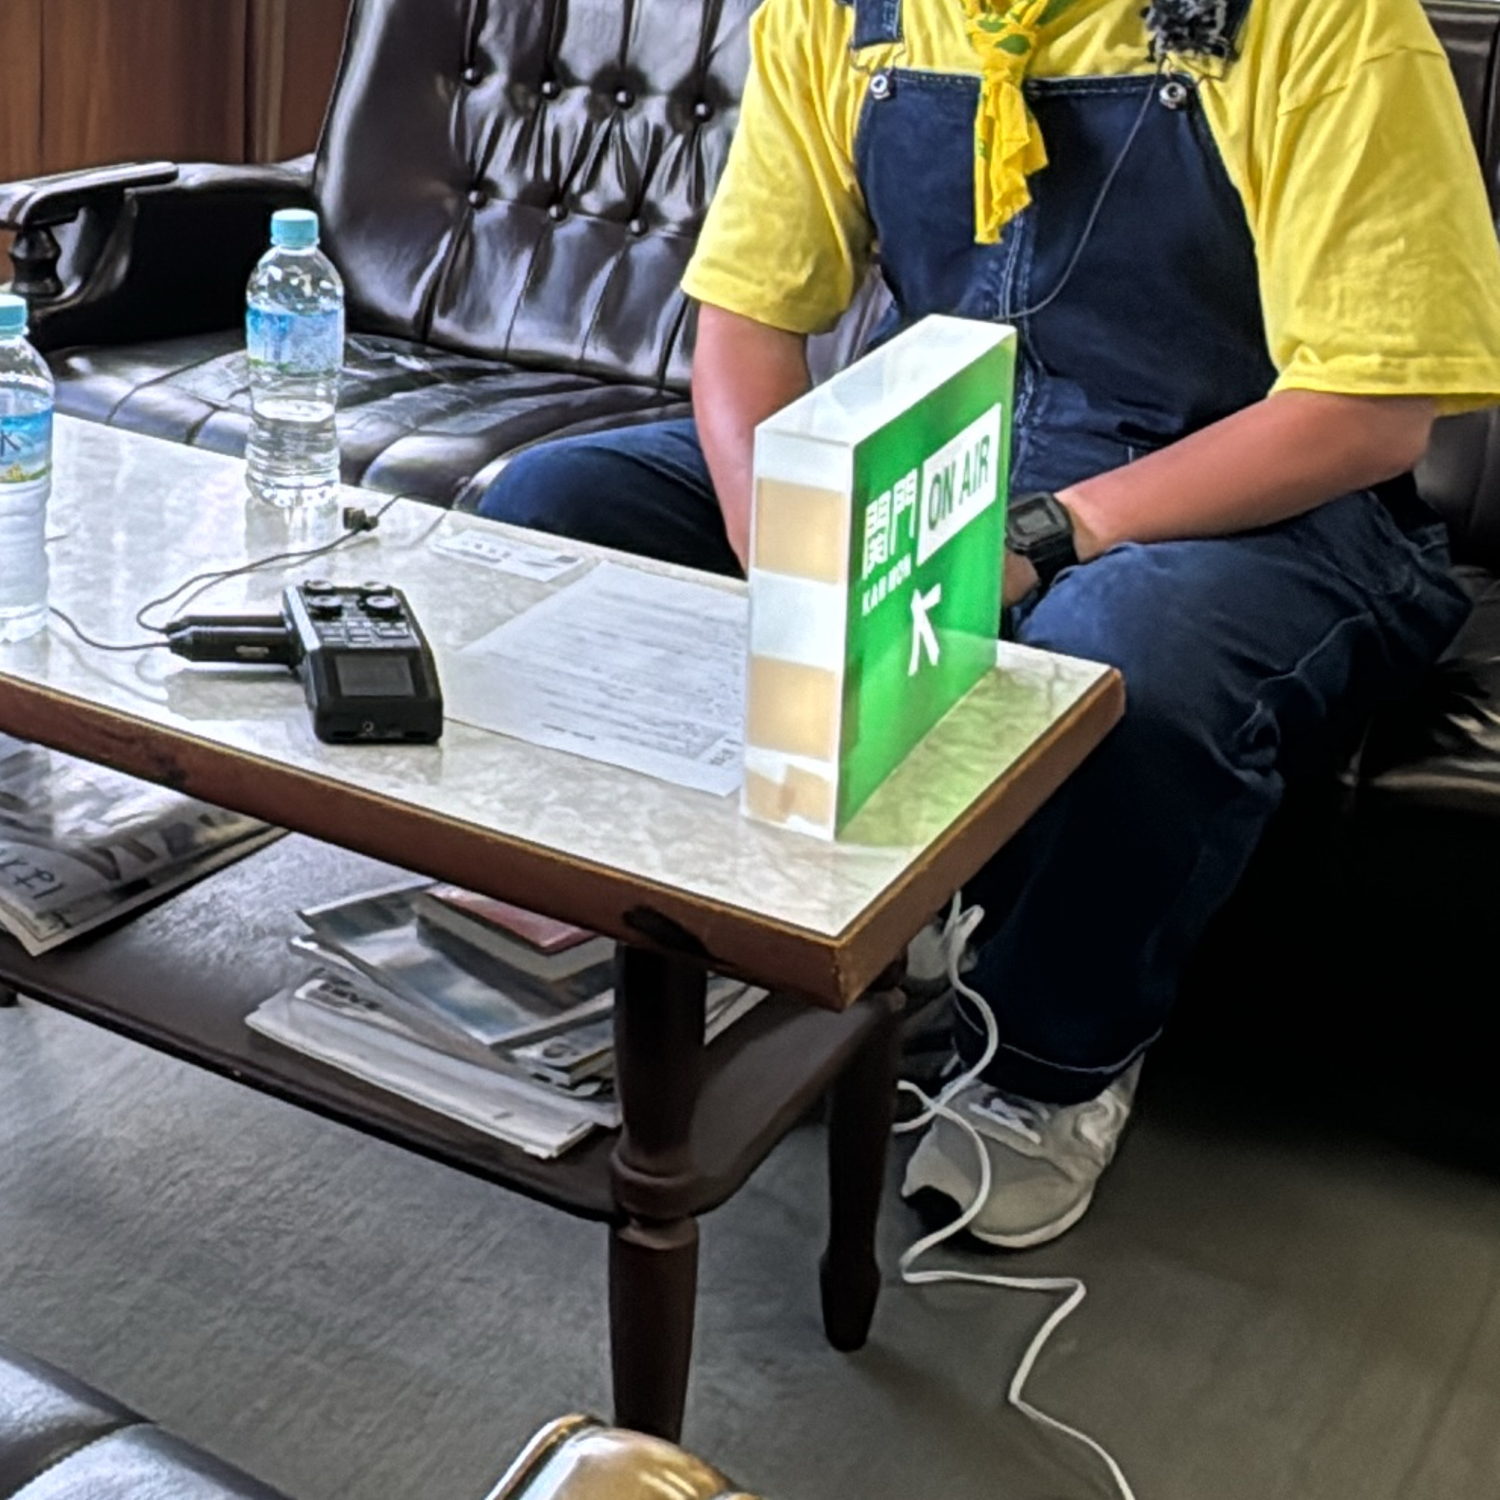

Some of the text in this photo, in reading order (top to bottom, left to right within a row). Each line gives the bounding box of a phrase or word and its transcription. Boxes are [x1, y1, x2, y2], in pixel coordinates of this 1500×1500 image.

[861, 468, 918, 581] 関門
[928, 434, 990, 531] ON AIR
